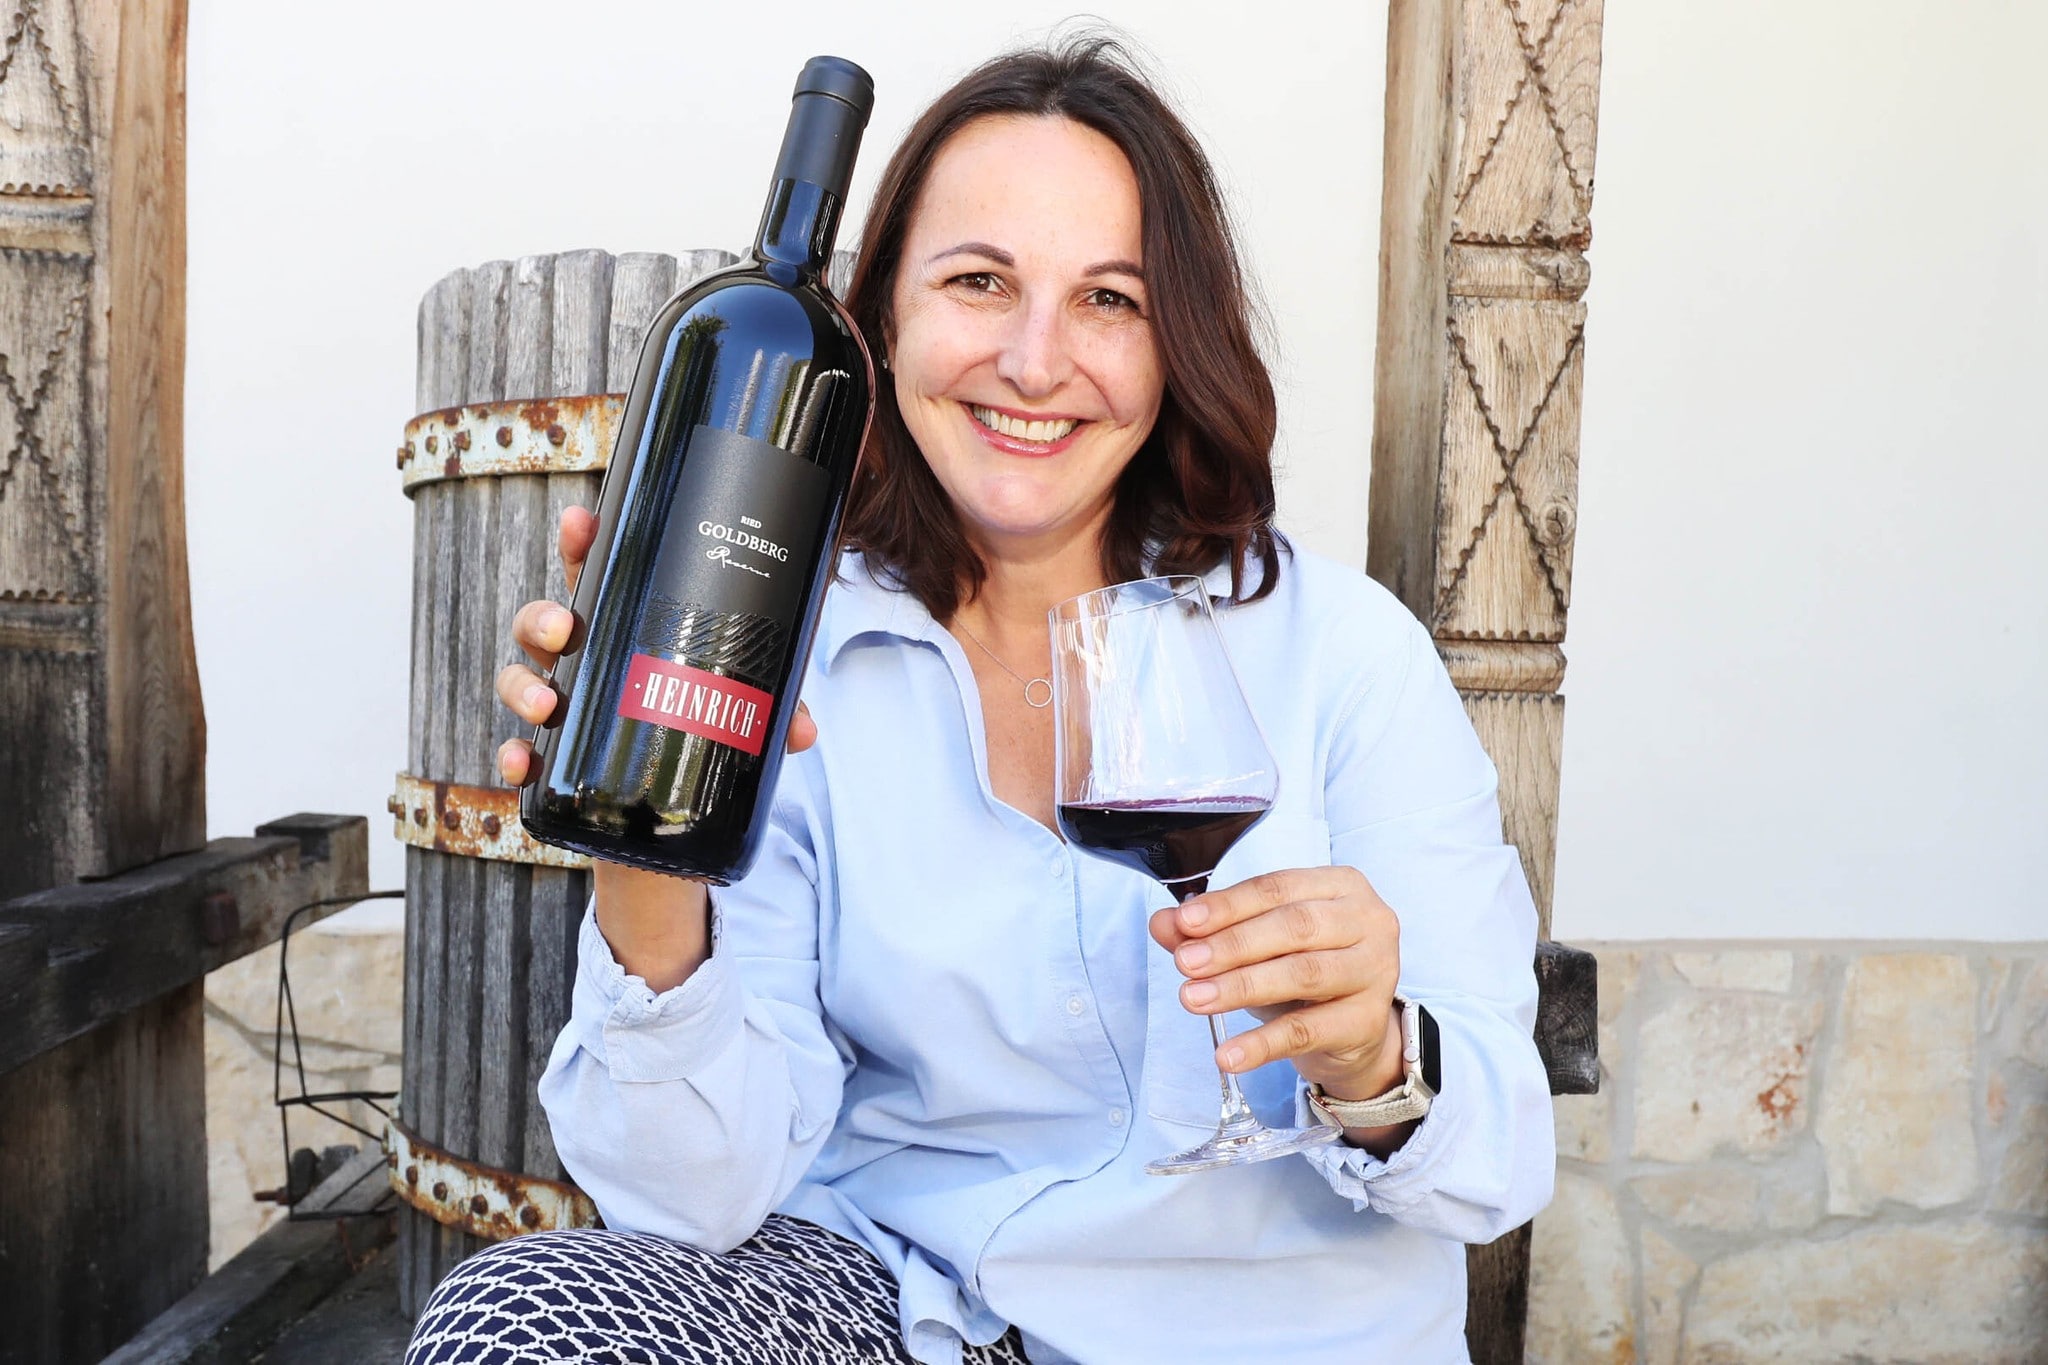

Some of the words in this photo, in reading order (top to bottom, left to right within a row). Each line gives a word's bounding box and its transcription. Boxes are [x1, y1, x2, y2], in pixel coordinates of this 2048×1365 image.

[698, 520, 789, 562] GOLDBERG
[740, 515, 763, 529] RIED
[641, 672, 758, 739] HEINRICH
